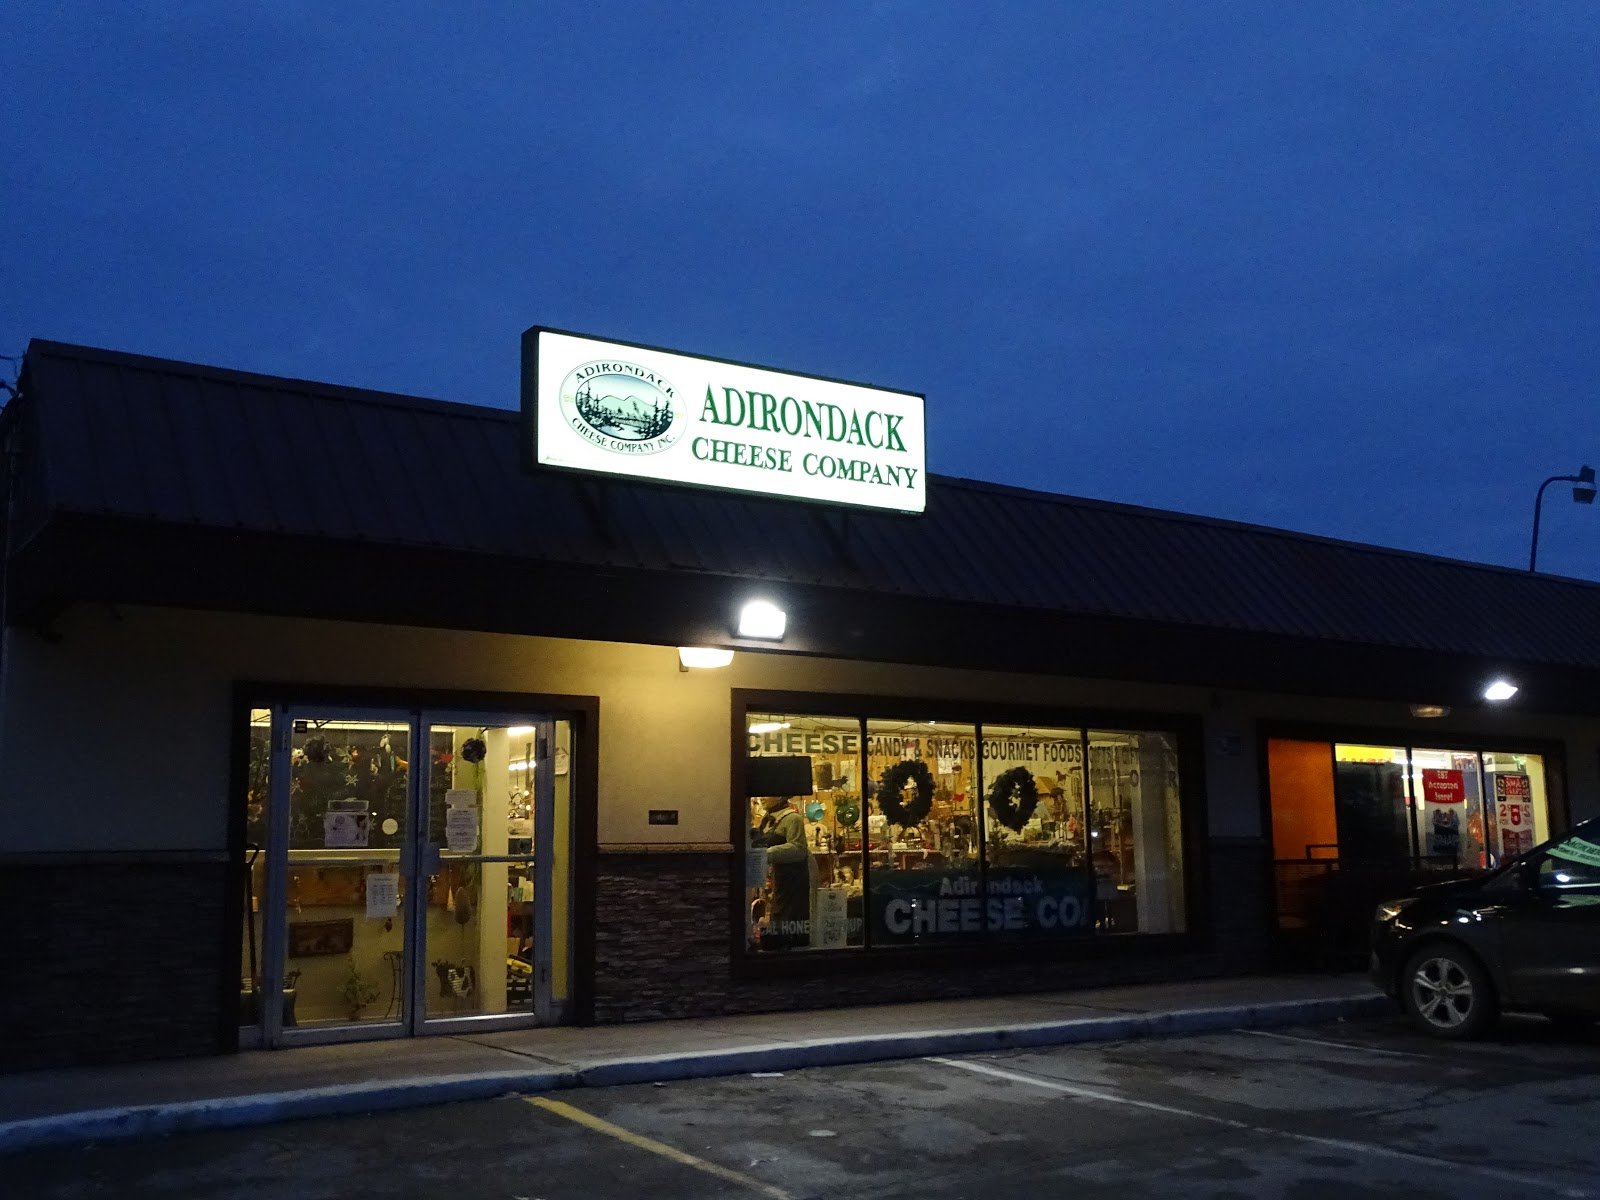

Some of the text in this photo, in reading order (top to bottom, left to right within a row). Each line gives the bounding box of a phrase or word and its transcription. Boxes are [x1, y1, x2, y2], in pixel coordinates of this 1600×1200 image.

[575, 363, 674, 398] ADIRONDACK
[699, 382, 907, 452] ADIRONDACK
[572, 417, 676, 453] CHEESE COMPANY INC.
[692, 437, 918, 489] CHEESE COMPANY
[748, 733, 858, 755] CHEESE
[866, 736, 908, 757] CANDY
[926, 738, 976, 760] SNACKS
[982, 740, 1082, 763] GOURMET FOODS
[940, 875, 1044, 897] Adirndack
[781, 920, 811, 935] HONE
[885, 896, 1025, 935] CHEESE
